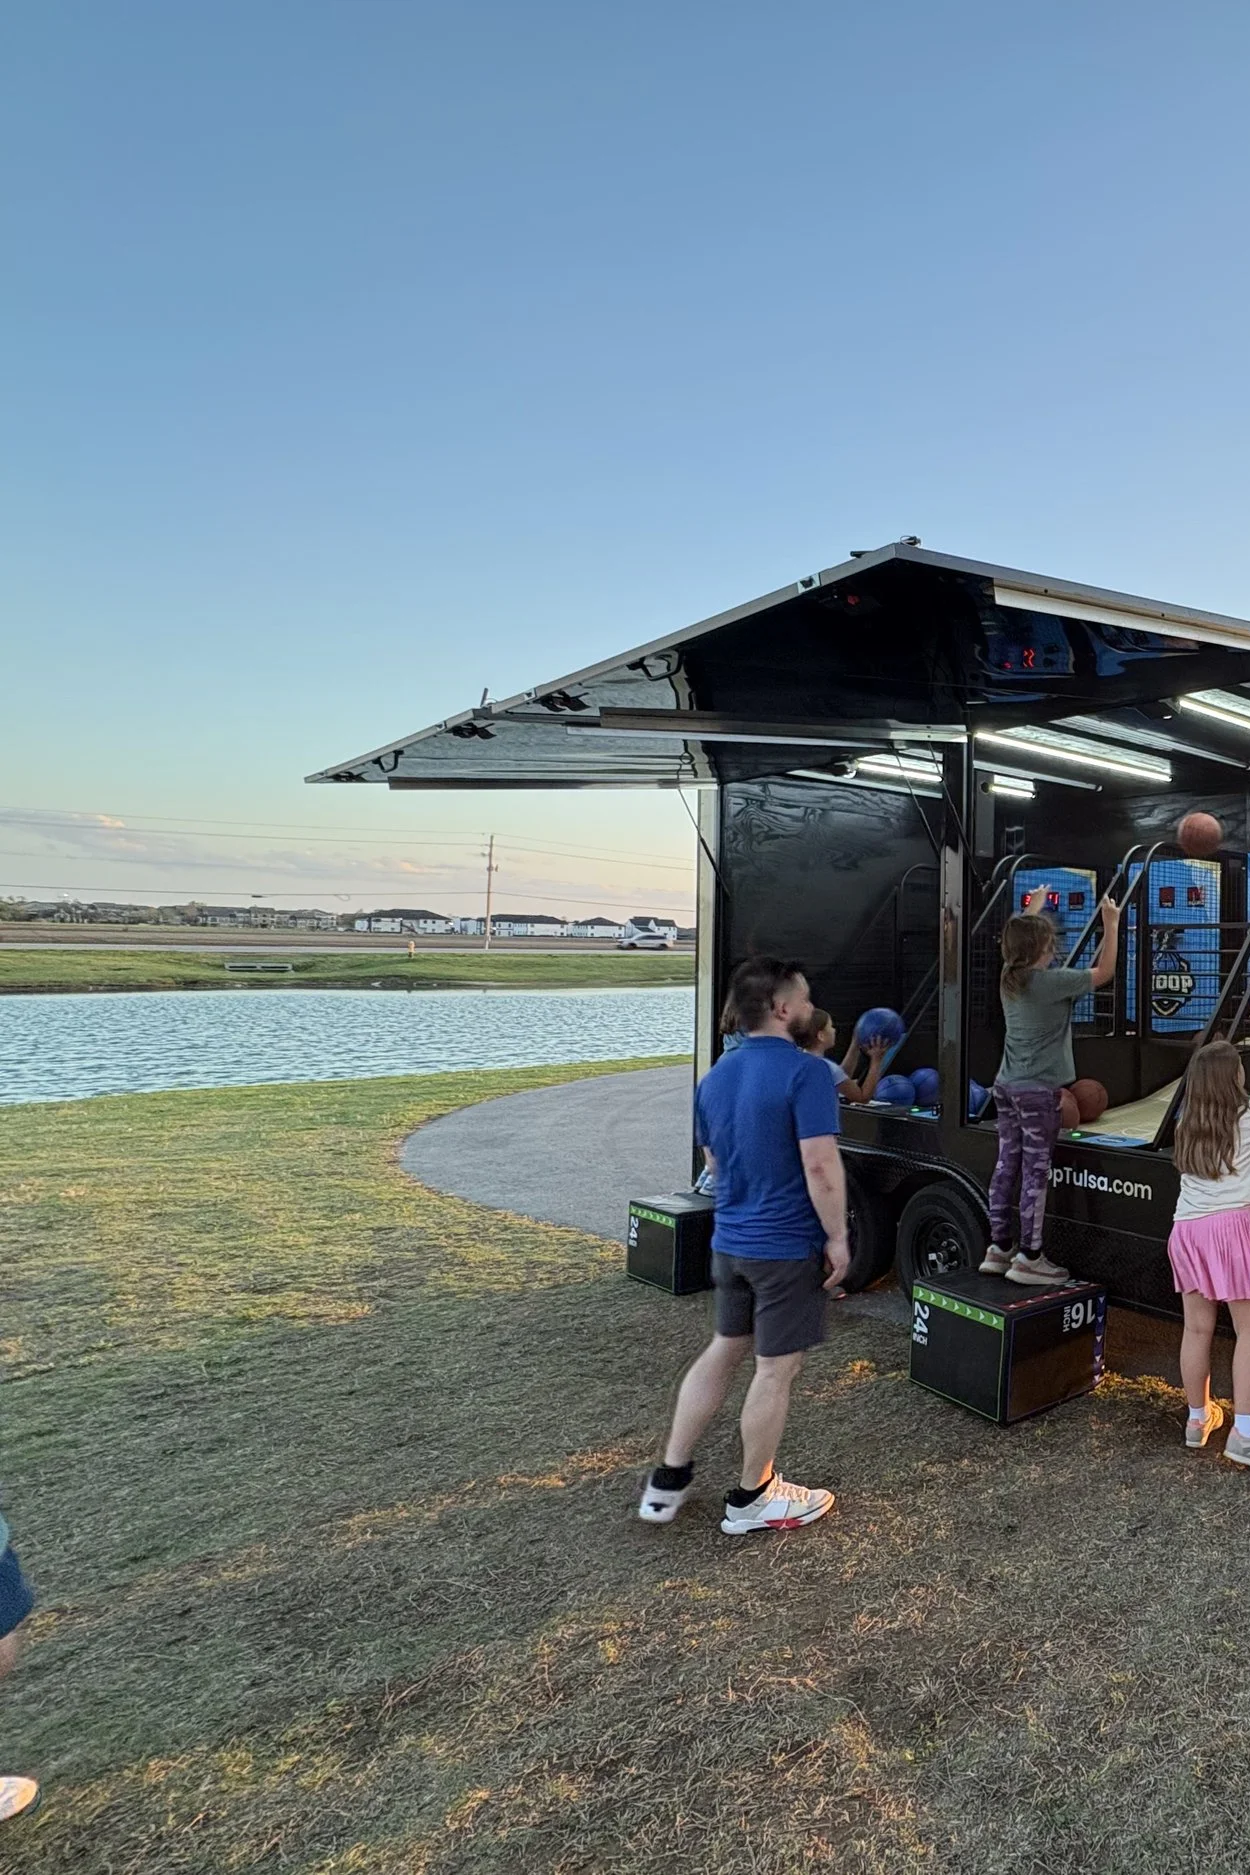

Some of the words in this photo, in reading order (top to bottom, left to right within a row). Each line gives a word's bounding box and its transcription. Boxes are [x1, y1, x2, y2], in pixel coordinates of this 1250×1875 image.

[630, 1216, 639, 1239] 24
[913, 1301, 930, 1334] 24
[1062, 1305, 1071, 1333] INCH
[1071, 1299, 1096, 1329] 16
